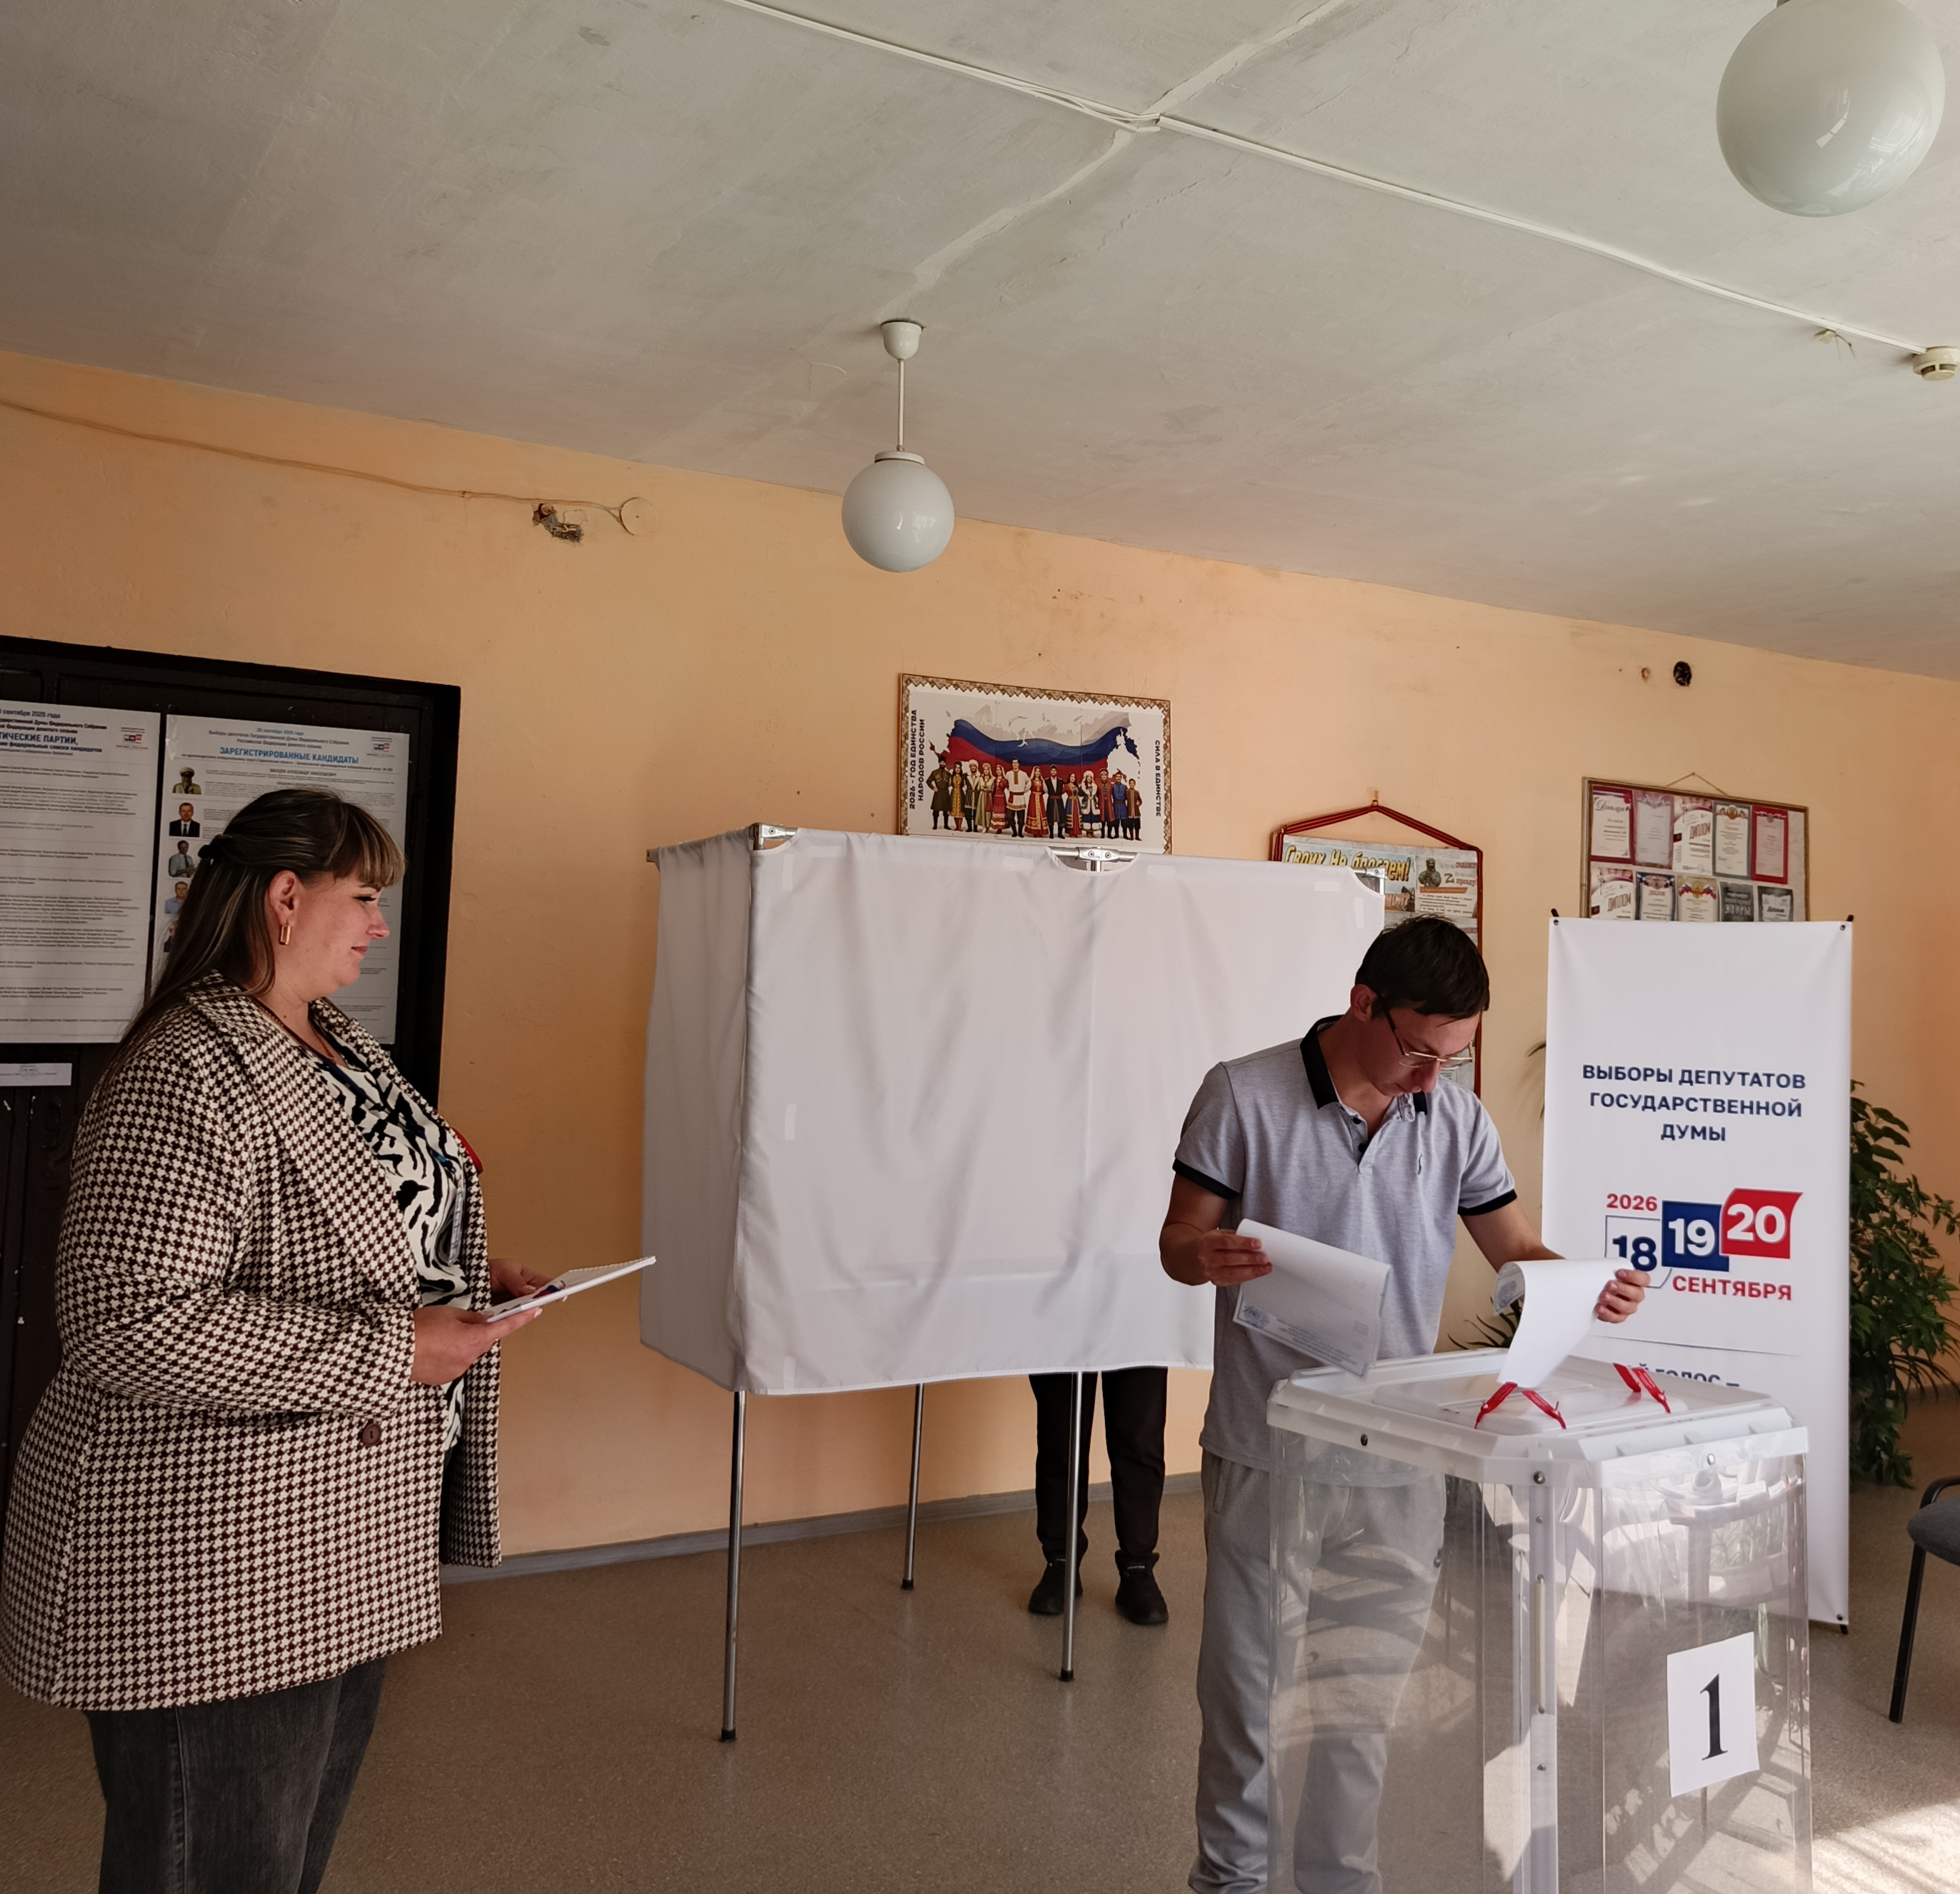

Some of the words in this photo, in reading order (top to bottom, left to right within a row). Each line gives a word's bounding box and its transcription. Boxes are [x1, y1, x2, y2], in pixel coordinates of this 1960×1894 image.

[44, 735, 79, 745] ПАРТИИ,
[220, 746, 310, 761] ЗАРЕГИСТРИРОВАННЫЕ
[313, 754, 359, 764] КАНДИДАТЫ
[1607, 893, 1631, 912] ДИПЛОМ
[1582, 1065, 1673, 1083] ВЫБОРЫ
[1679, 1069, 1806, 1089] ДЕПУТАТОВ
[1590, 1092, 1802, 1117] ГОСУДАРСТВЕННОЙ
[1661, 1123, 1726, 1141] ДУМЫ
[1606, 1193, 1657, 1211] 2026
[1612, 1235, 1657, 1272] 18
[1669, 1218, 1715, 1256] 19
[1726, 1203, 1786, 1243] 20
[1672, 1276, 1792, 1301] СЕНТЯБРЯ
[1700, 1673, 1728, 1760] 1
